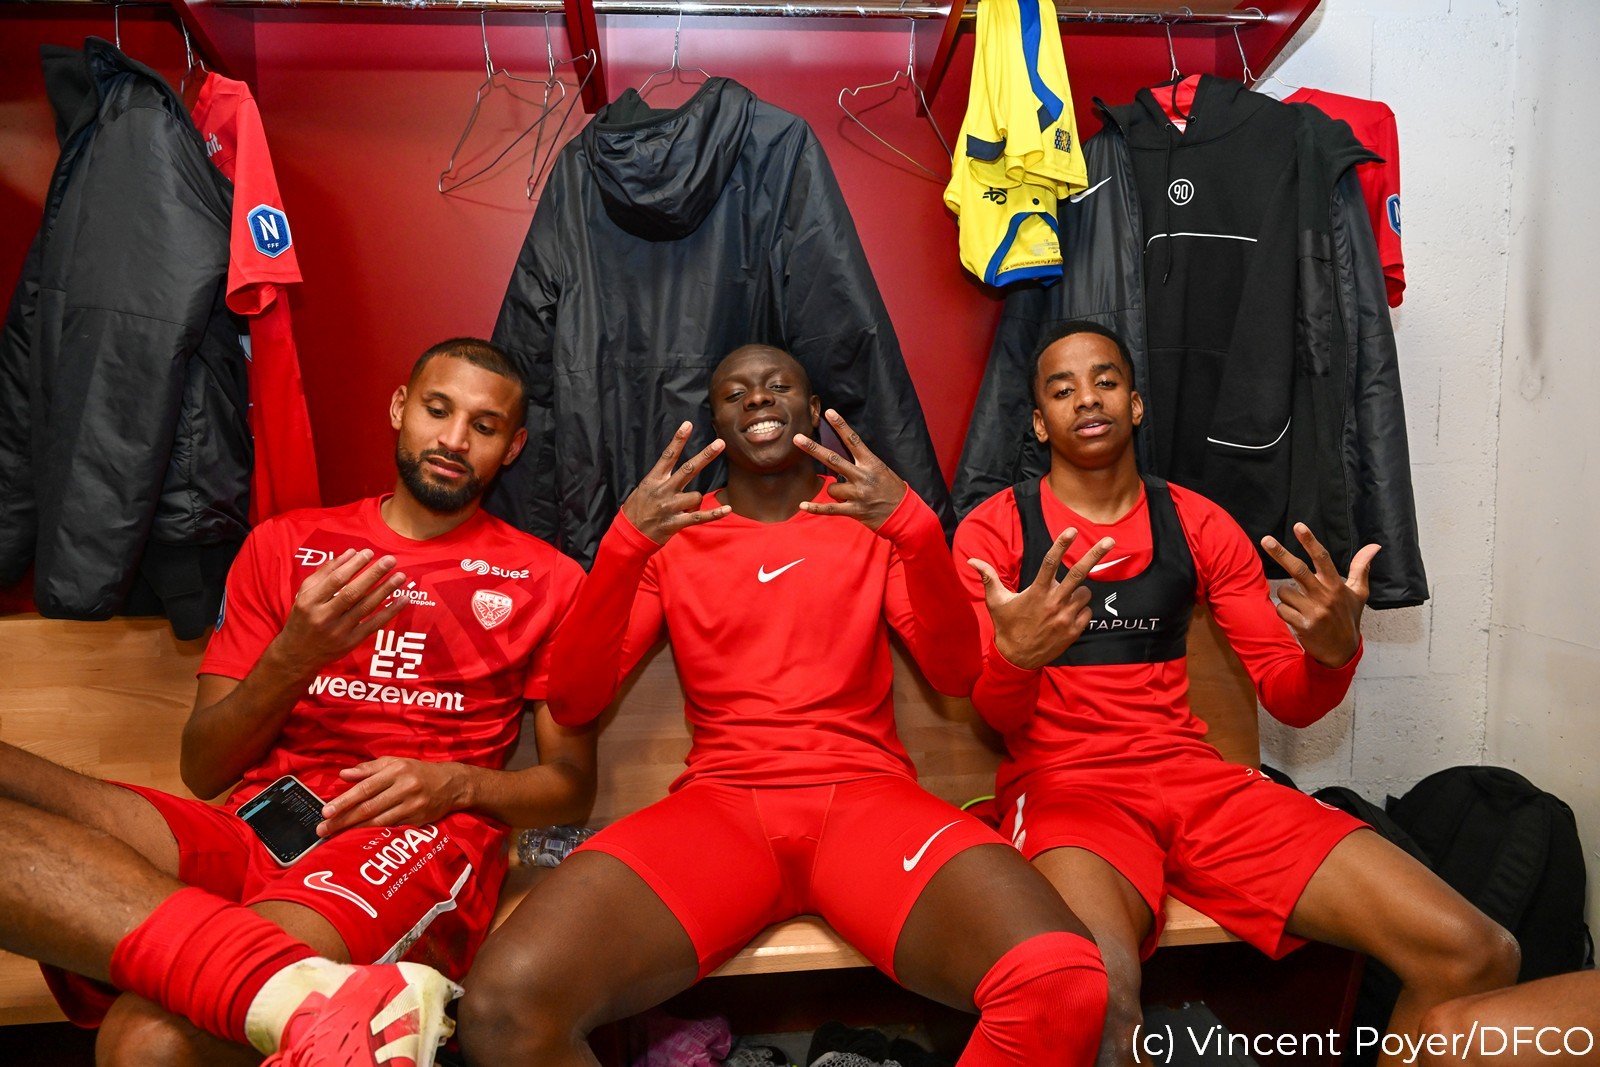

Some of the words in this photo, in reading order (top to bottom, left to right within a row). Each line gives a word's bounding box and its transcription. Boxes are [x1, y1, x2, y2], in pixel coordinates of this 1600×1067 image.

[1173, 184, 1189, 200] 90
[256, 214, 280, 241] N
[1089, 618, 1160, 630] TAPULT
[308, 675, 465, 712] weezevent
